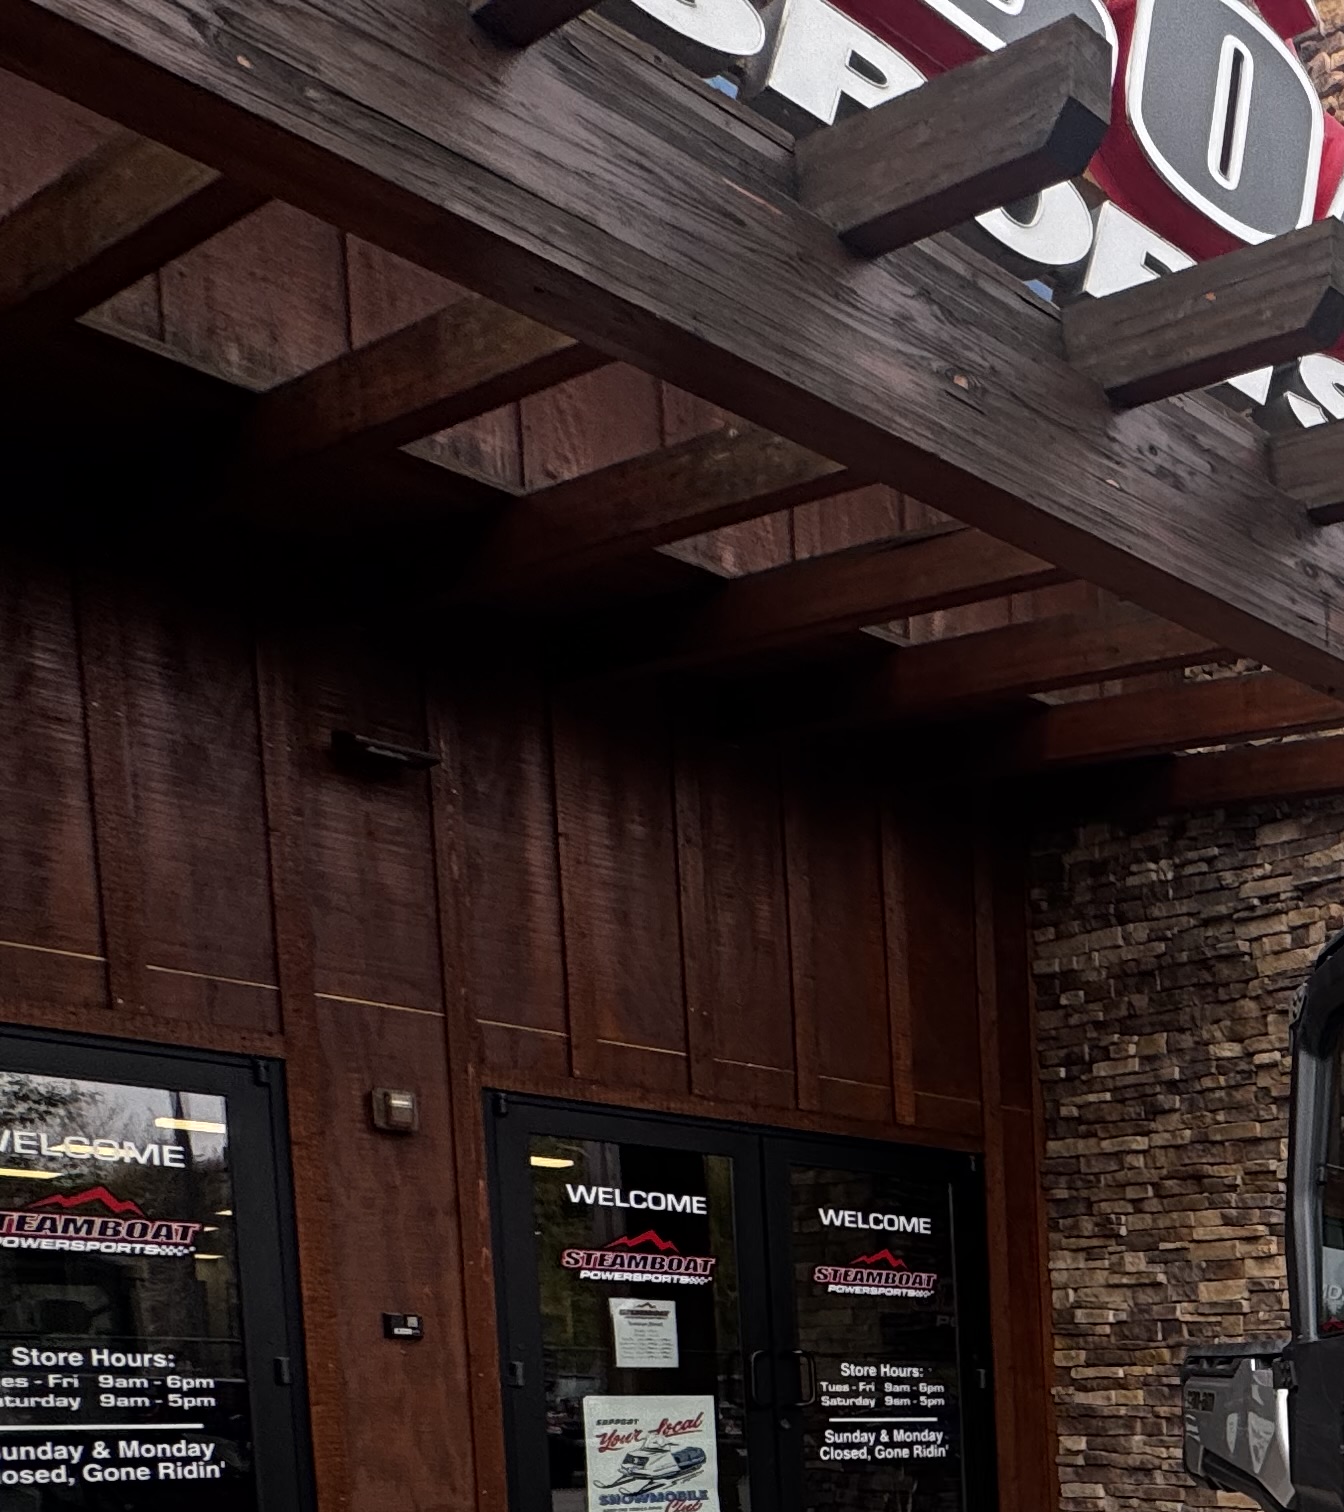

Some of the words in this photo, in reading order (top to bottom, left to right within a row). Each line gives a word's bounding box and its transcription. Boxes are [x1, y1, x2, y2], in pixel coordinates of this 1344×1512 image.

[565, 1184, 707, 1215] WELCOME
[0, 1211, 201, 1244] TEAMBOAT
[818, 1208, 932, 1234] WELCOME
[0, 1236, 159, 1256] OWERSPORTS
[562, 1249, 716, 1275] STEAMBOAT
[579, 1270, 690, 1284] POWERSPORTS
[813, 1266, 937, 1289] STEAMBOAT
[827, 1284, 916, 1298] POWERSPORTS
[12, 1347, 83, 1367] Store
[91, 1349, 175, 1367] Hours:
[840, 1362, 877, 1377] Store
[880, 1364, 924, 1378] Hours:
[1, 1377, 29, 1388] es
[48, 1374, 79, 1388] Fri
[98, 1375, 149, 1388] 9am
[167, 1375, 215, 1391] 6pm
[820, 1382, 850, 1392] Tues
[858, 1382, 875, 1392] Fri
[884, 1383, 911, 1392] 9am
[0, 1394, 81, 1411] turday
[100, 1394, 150, 1407] 9am
[168, 1394, 216, 1410] 5pm
[821, 1396, 876, 1408] Saturday
[884, 1396, 911, 1406] 9am
[919, 1396, 945, 1408] 5pm
[595, 1429, 643, 1453] Your
[824, 1429, 876, 1446] Sunday
[879, 1429, 889, 1443] &
[893, 1428, 943, 1444] Monday
[0, 1442, 84, 1464] unday
[92, 1441, 111, 1459] &
[118, 1440, 215, 1461] Monday
[819, 1446, 872, 1461] Closed,
[874, 1446, 910, 1459] Gone
[913, 1445, 949, 1458] Ridin'
[1, 1465, 76, 1486] osed,
[82, 1464, 151, 1482] Gone
[158, 1461, 226, 1480] Ridin'
[598, 1489, 709, 1506] SNOWMOBILE
